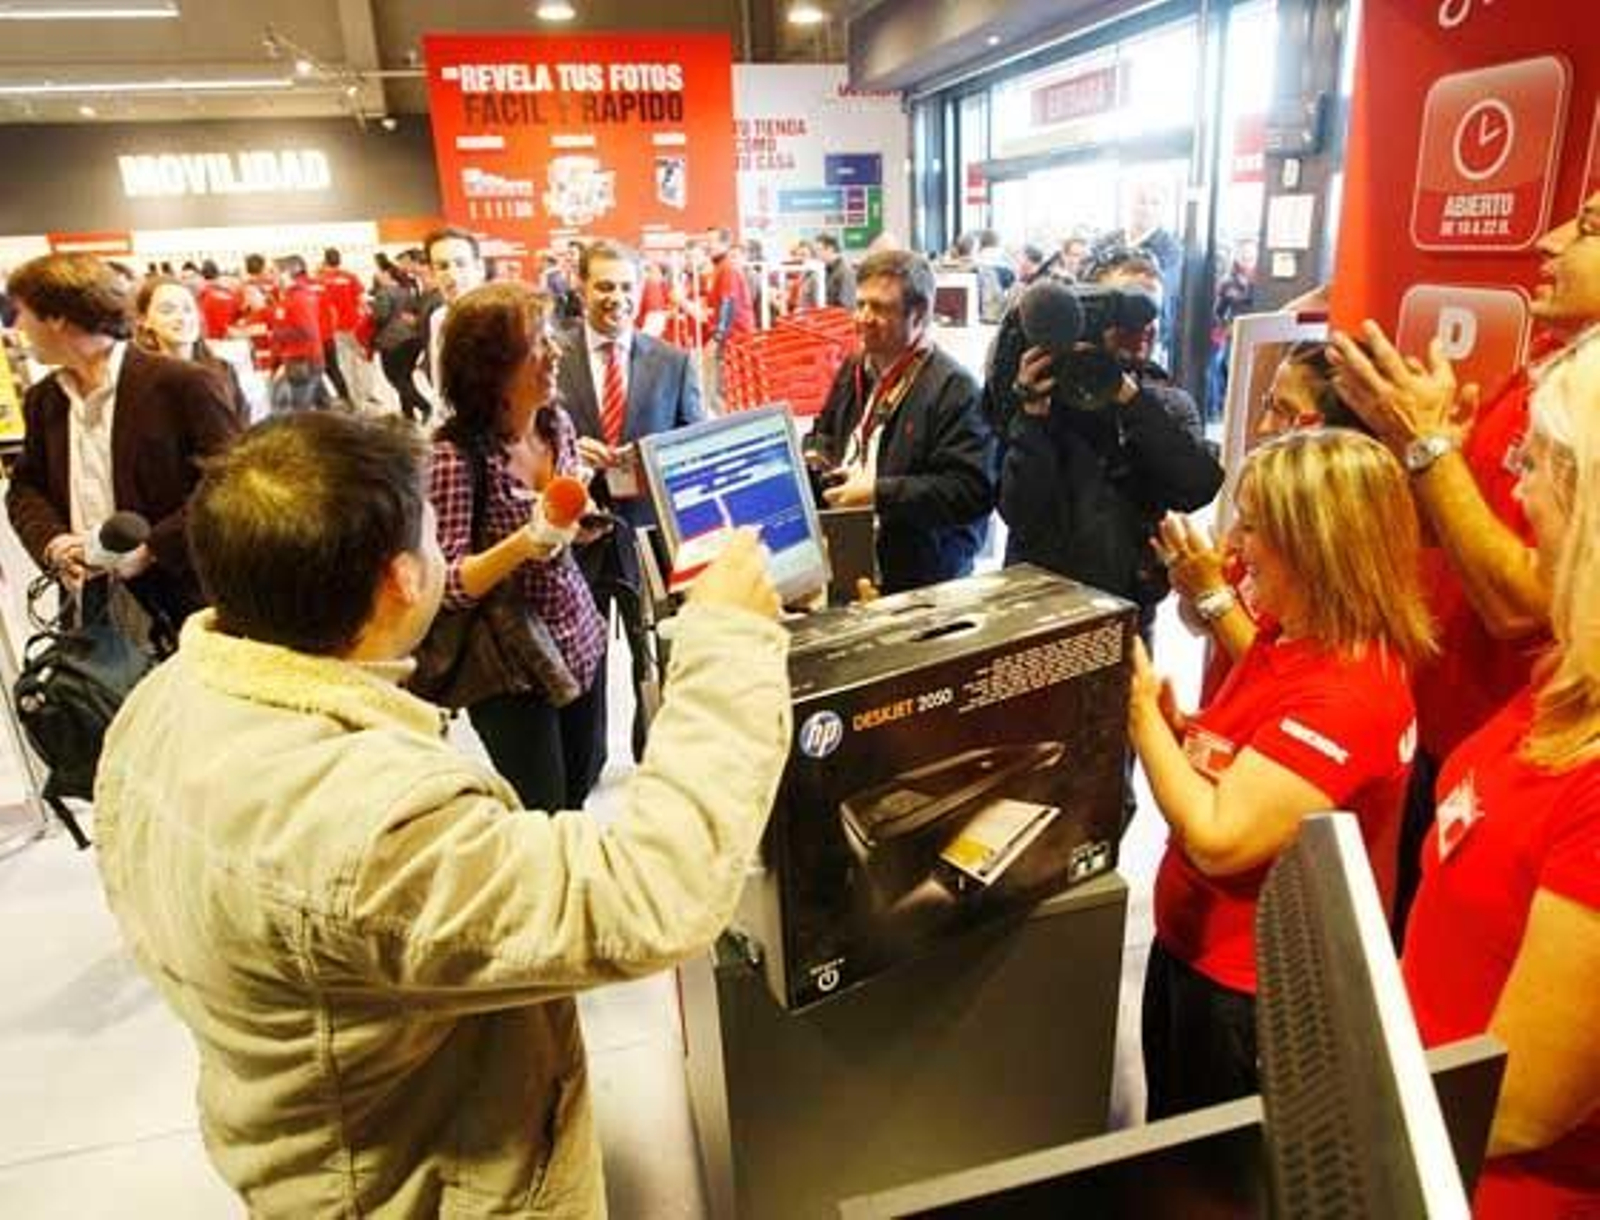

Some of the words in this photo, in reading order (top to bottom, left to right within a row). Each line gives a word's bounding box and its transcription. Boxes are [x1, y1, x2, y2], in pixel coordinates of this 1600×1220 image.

[459, 64, 553, 92] REVELA
[556, 64, 604, 91] TUS
[609, 63, 683, 91] FOTOS
[754, 118, 807, 134] TIENDA
[118, 151, 330, 196] MOVILIDAD
[756, 152, 795, 169] CASA
[1444, 193, 1514, 217] ABIERTO
[853, 699, 914, 731] DESKJET
[918, 687, 953, 712] 2050
